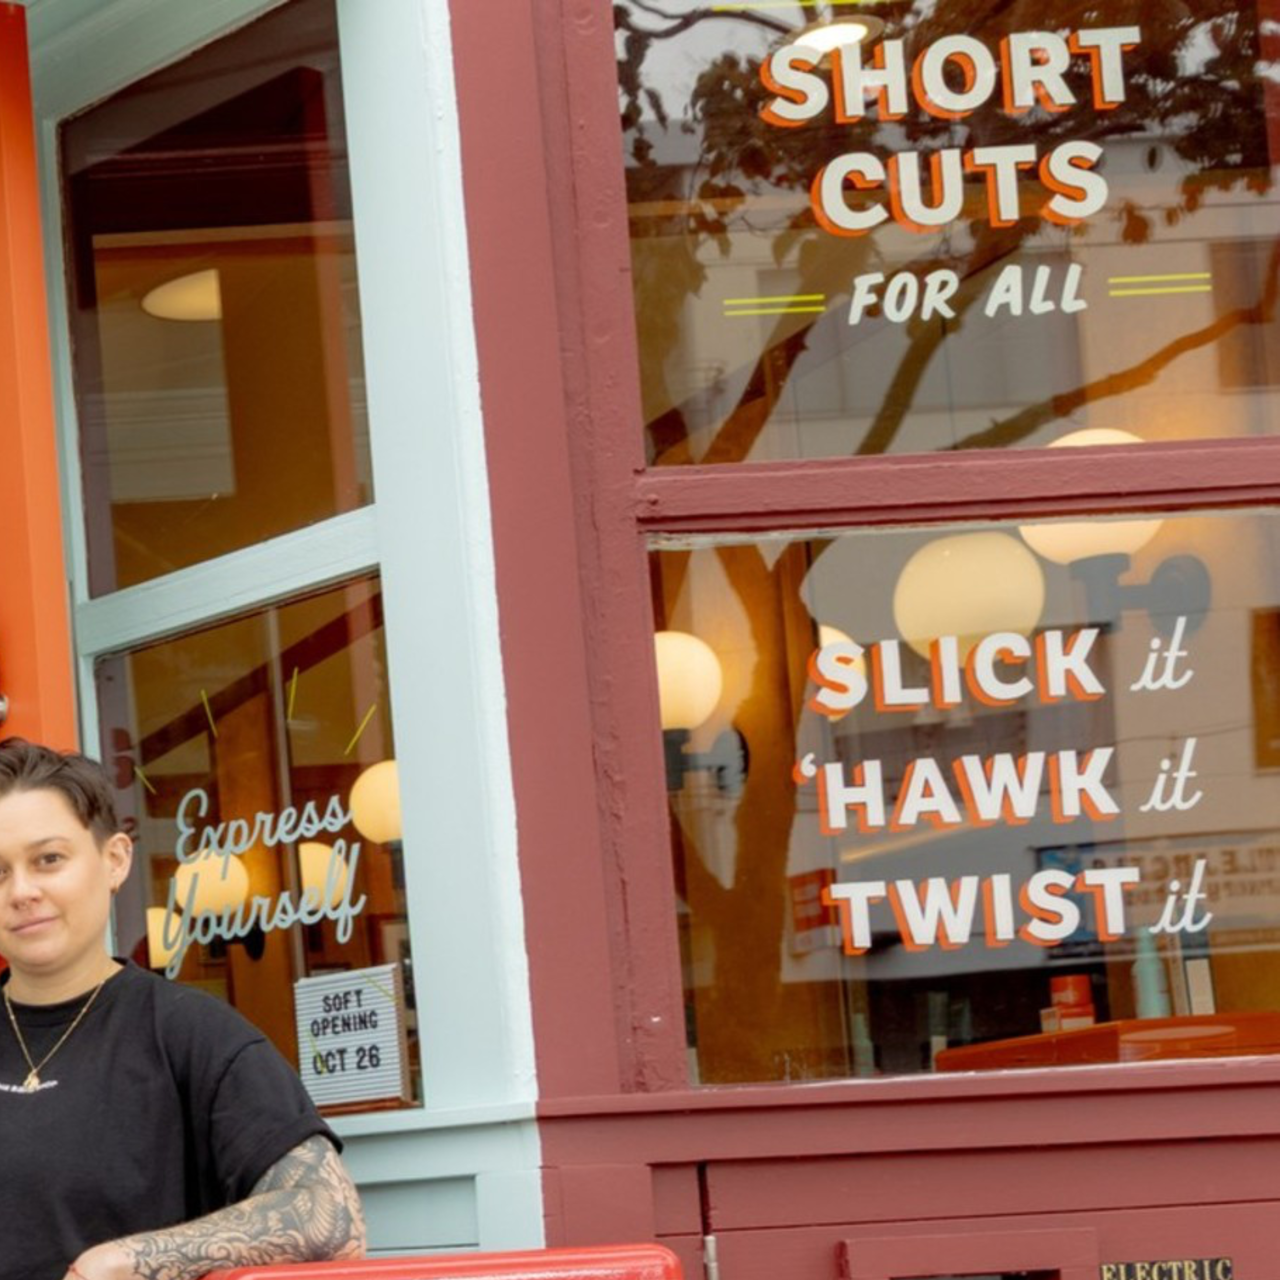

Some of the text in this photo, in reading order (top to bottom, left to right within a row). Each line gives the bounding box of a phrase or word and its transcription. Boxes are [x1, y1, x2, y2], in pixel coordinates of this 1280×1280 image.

[758, 25, 1141, 128] SHORT
[811, 140, 1110, 238] CUTS
[848, 262, 1088, 326] FOR ALL
[807, 616, 1195, 718] SLICK it
[1140, 738, 1204, 812] it
[175, 788, 354, 882] Express
[162, 839, 367, 980] Yourself
[821, 859, 1213, 956] TWIST it
[310, 1010, 379, 1038] OPENING
[322, 989, 363, 1013] SOFT
[313, 1044, 381, 1075] OCT 26
